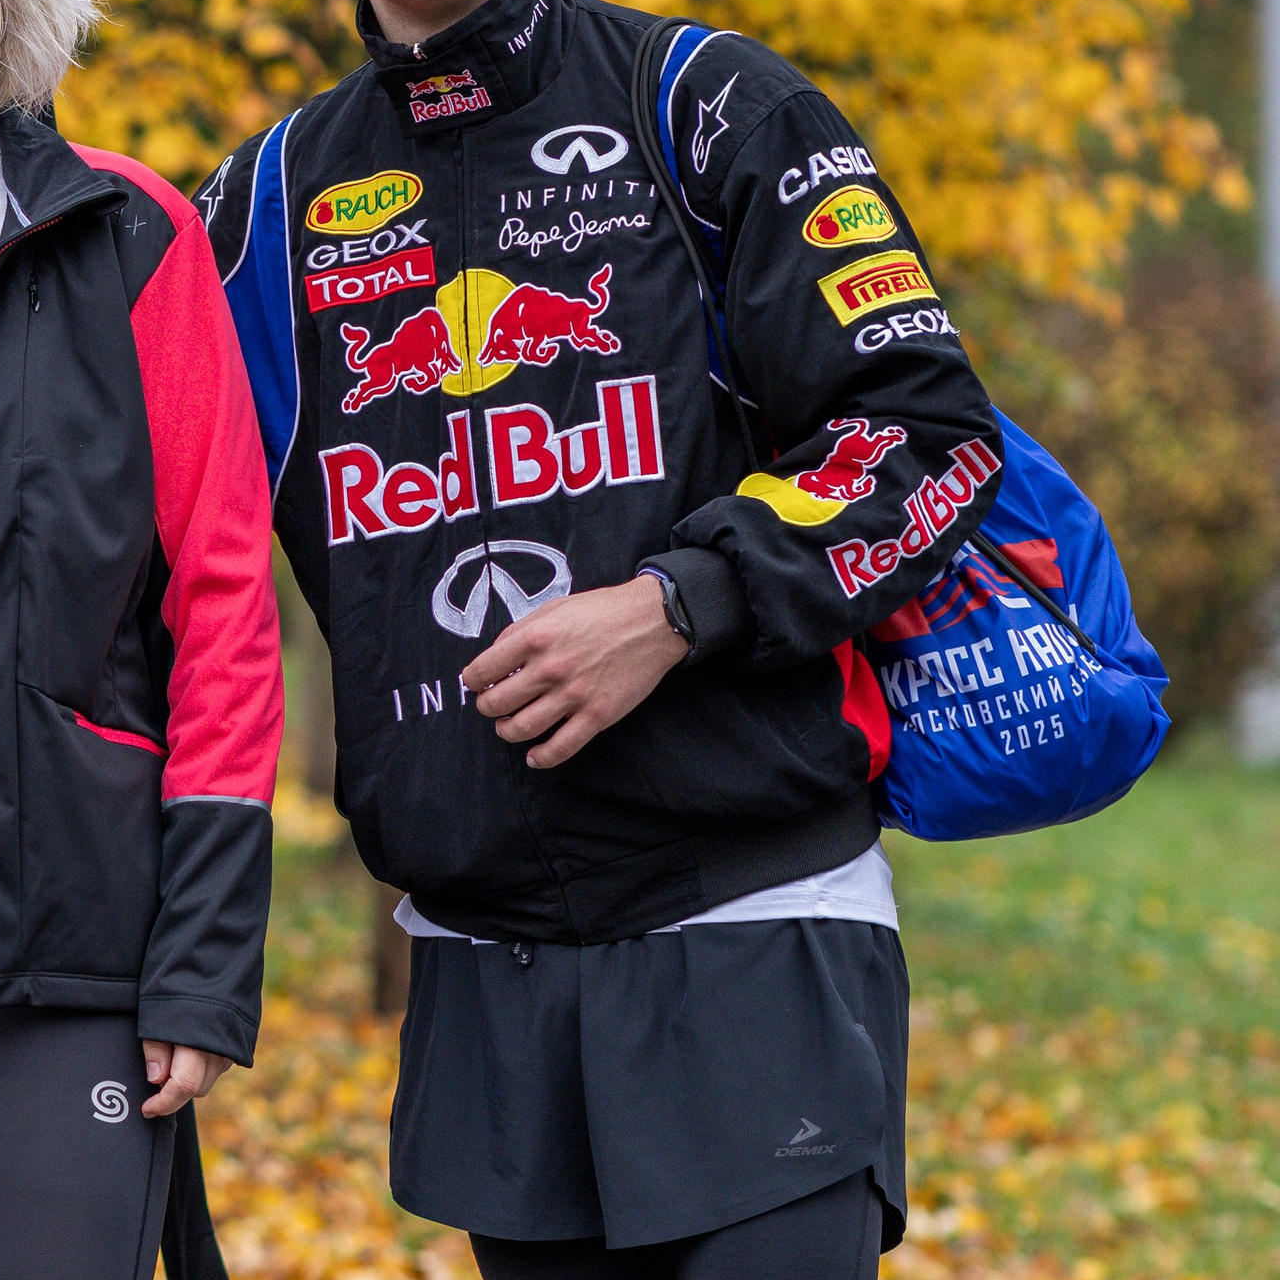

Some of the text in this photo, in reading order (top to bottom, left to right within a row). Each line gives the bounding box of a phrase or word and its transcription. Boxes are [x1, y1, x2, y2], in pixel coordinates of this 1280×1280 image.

[409, 87, 491, 123] Red Bull
[500, 180, 656, 214] INFINITI
[778, 146, 877, 205] CASIO
[334, 179, 409, 222] RAUCH
[306, 218, 430, 270] GEOX
[499, 212, 651, 257] Pepe Jeans
[312, 261, 430, 302] TOTAL
[854, 308, 960, 354] GEOX
[318, 374, 666, 547] Red Bull
[826, 437, 1002, 600] Red Bull
[880, 637, 1006, 711] КРОСС
[1000, 713, 1065, 755] 2025
[774, 1143, 837, 1158] DEMIX
